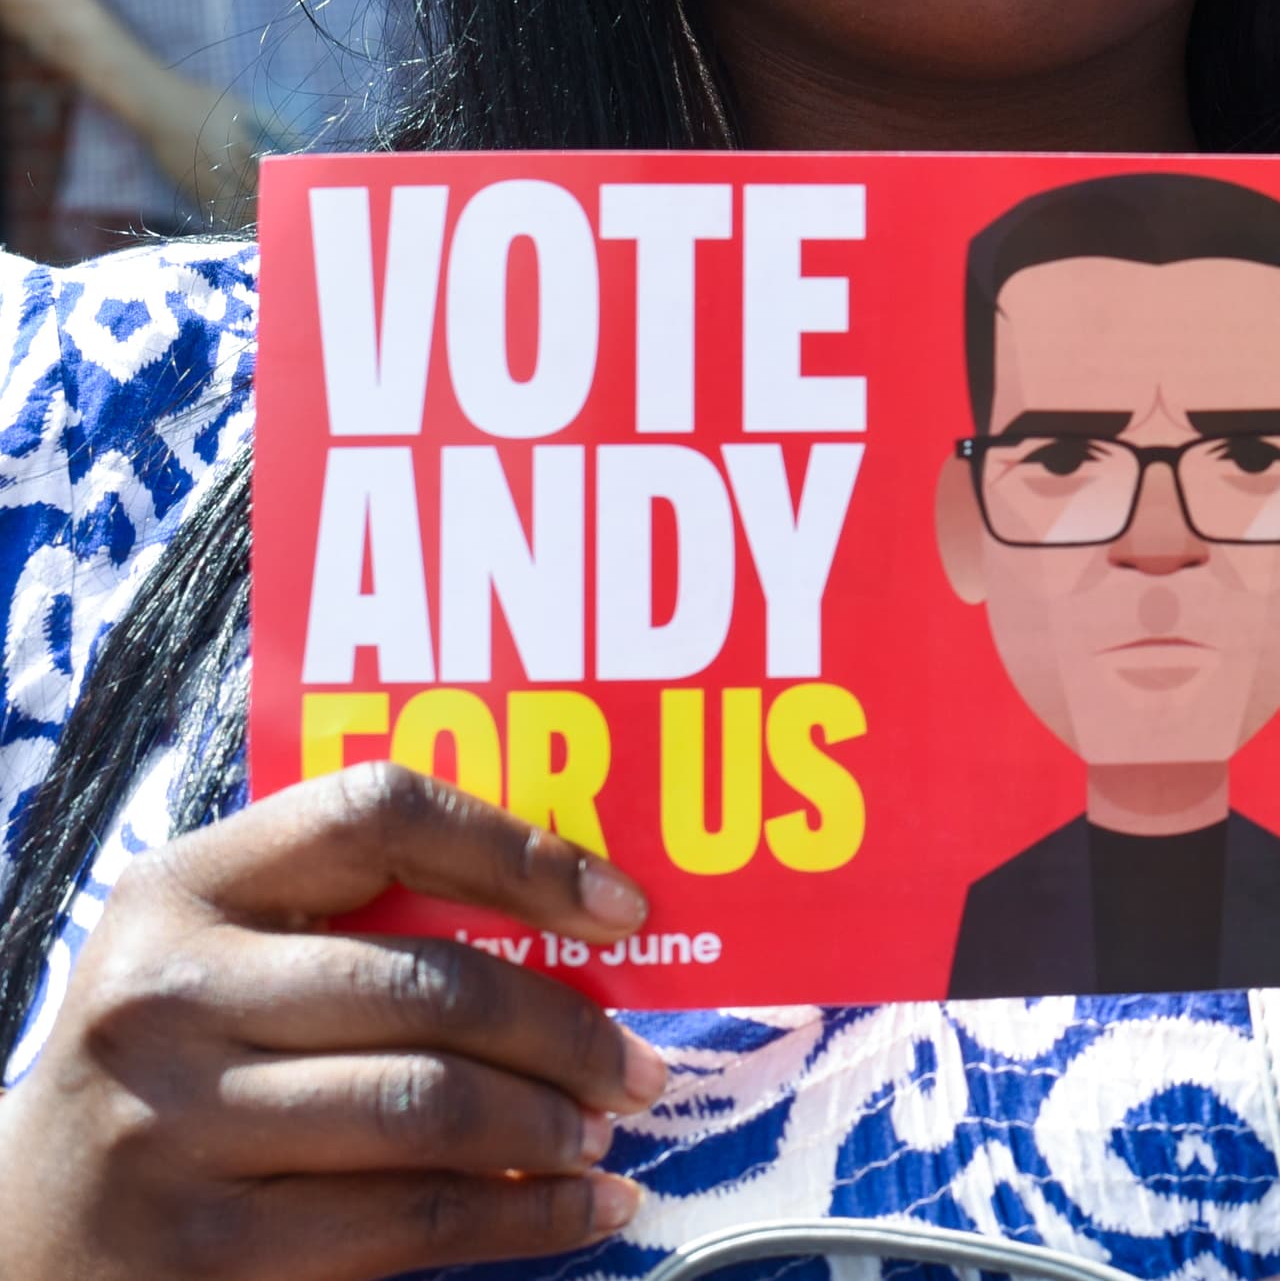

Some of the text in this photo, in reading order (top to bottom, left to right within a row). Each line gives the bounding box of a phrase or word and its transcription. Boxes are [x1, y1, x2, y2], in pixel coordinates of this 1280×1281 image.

[308, 179, 866, 438] VOTE
[301, 443, 866, 684] ANDY
[661, 683, 867, 875] US
[540, 931, 591, 967] 18
[600, 931, 722, 966] June
